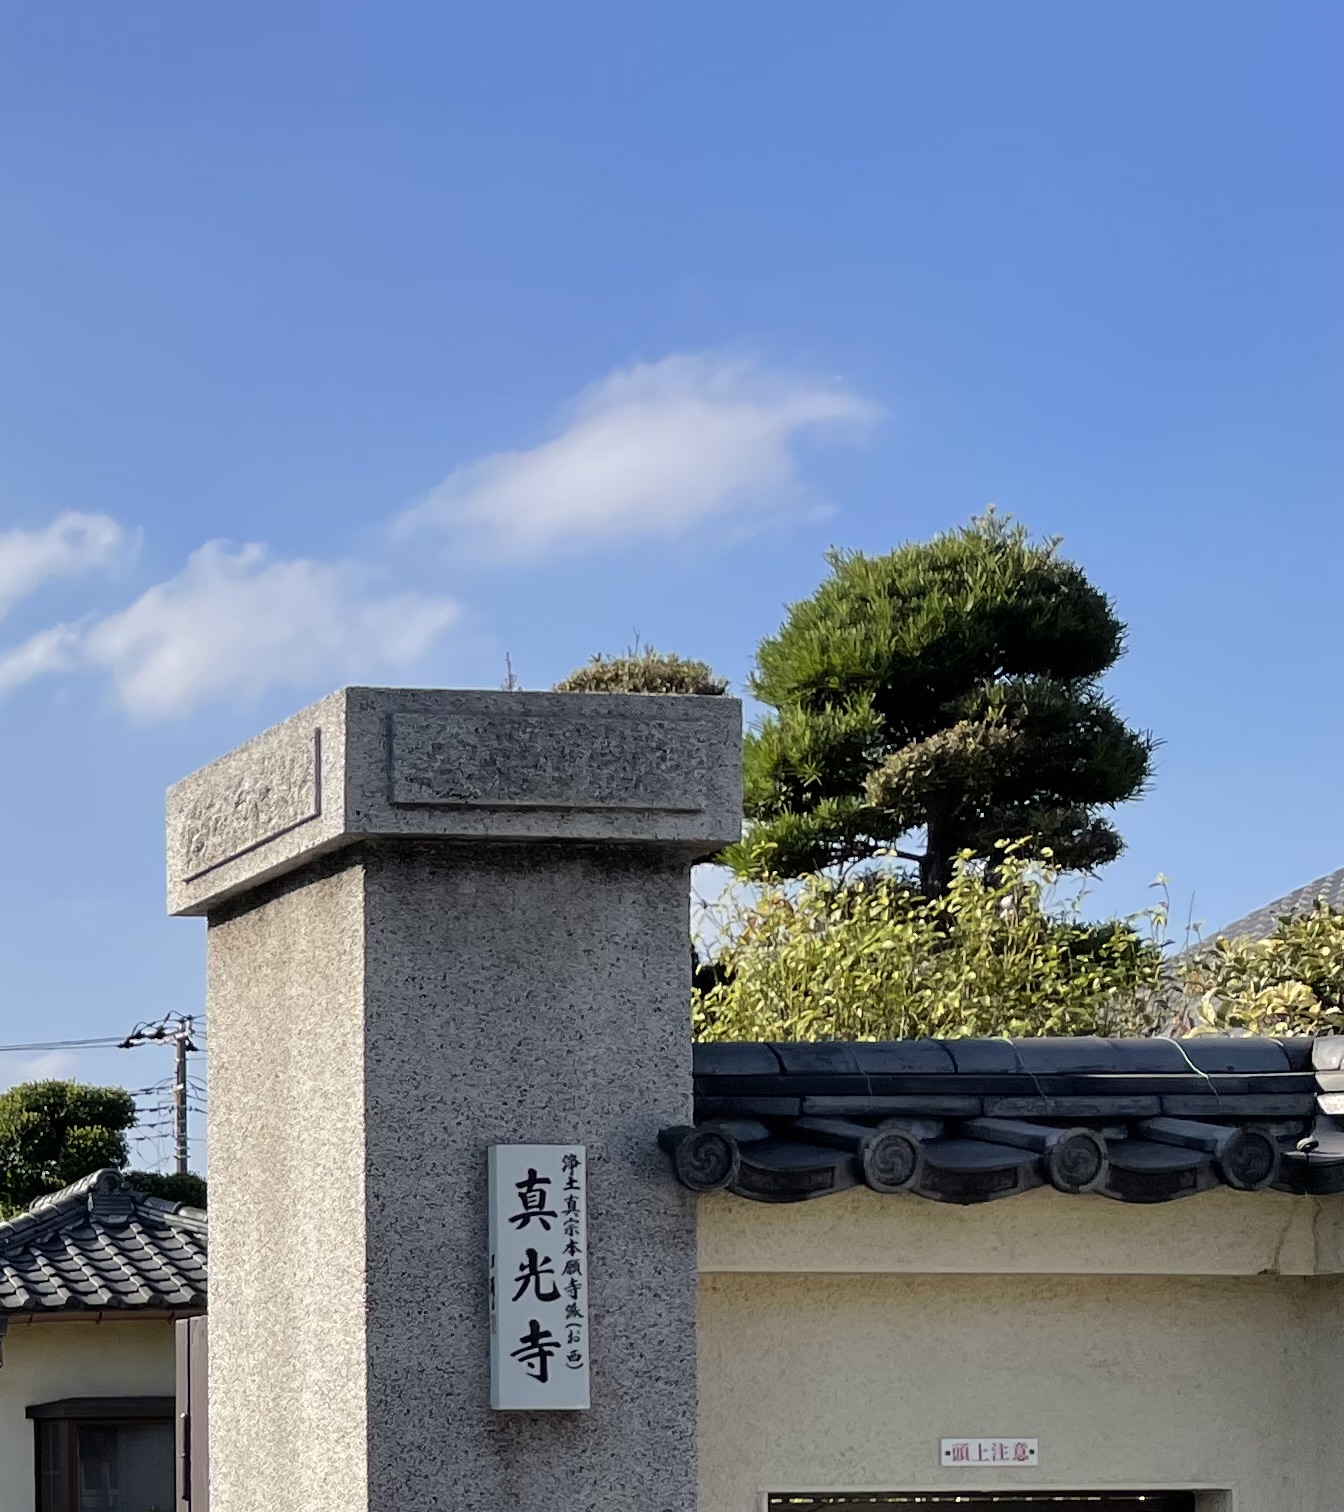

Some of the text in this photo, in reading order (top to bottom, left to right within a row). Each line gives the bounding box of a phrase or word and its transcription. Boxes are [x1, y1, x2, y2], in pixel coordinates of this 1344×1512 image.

[509, 1168, 562, 1383] 真光寺
[952, 1442, 1028, 1461] 頭上注意
